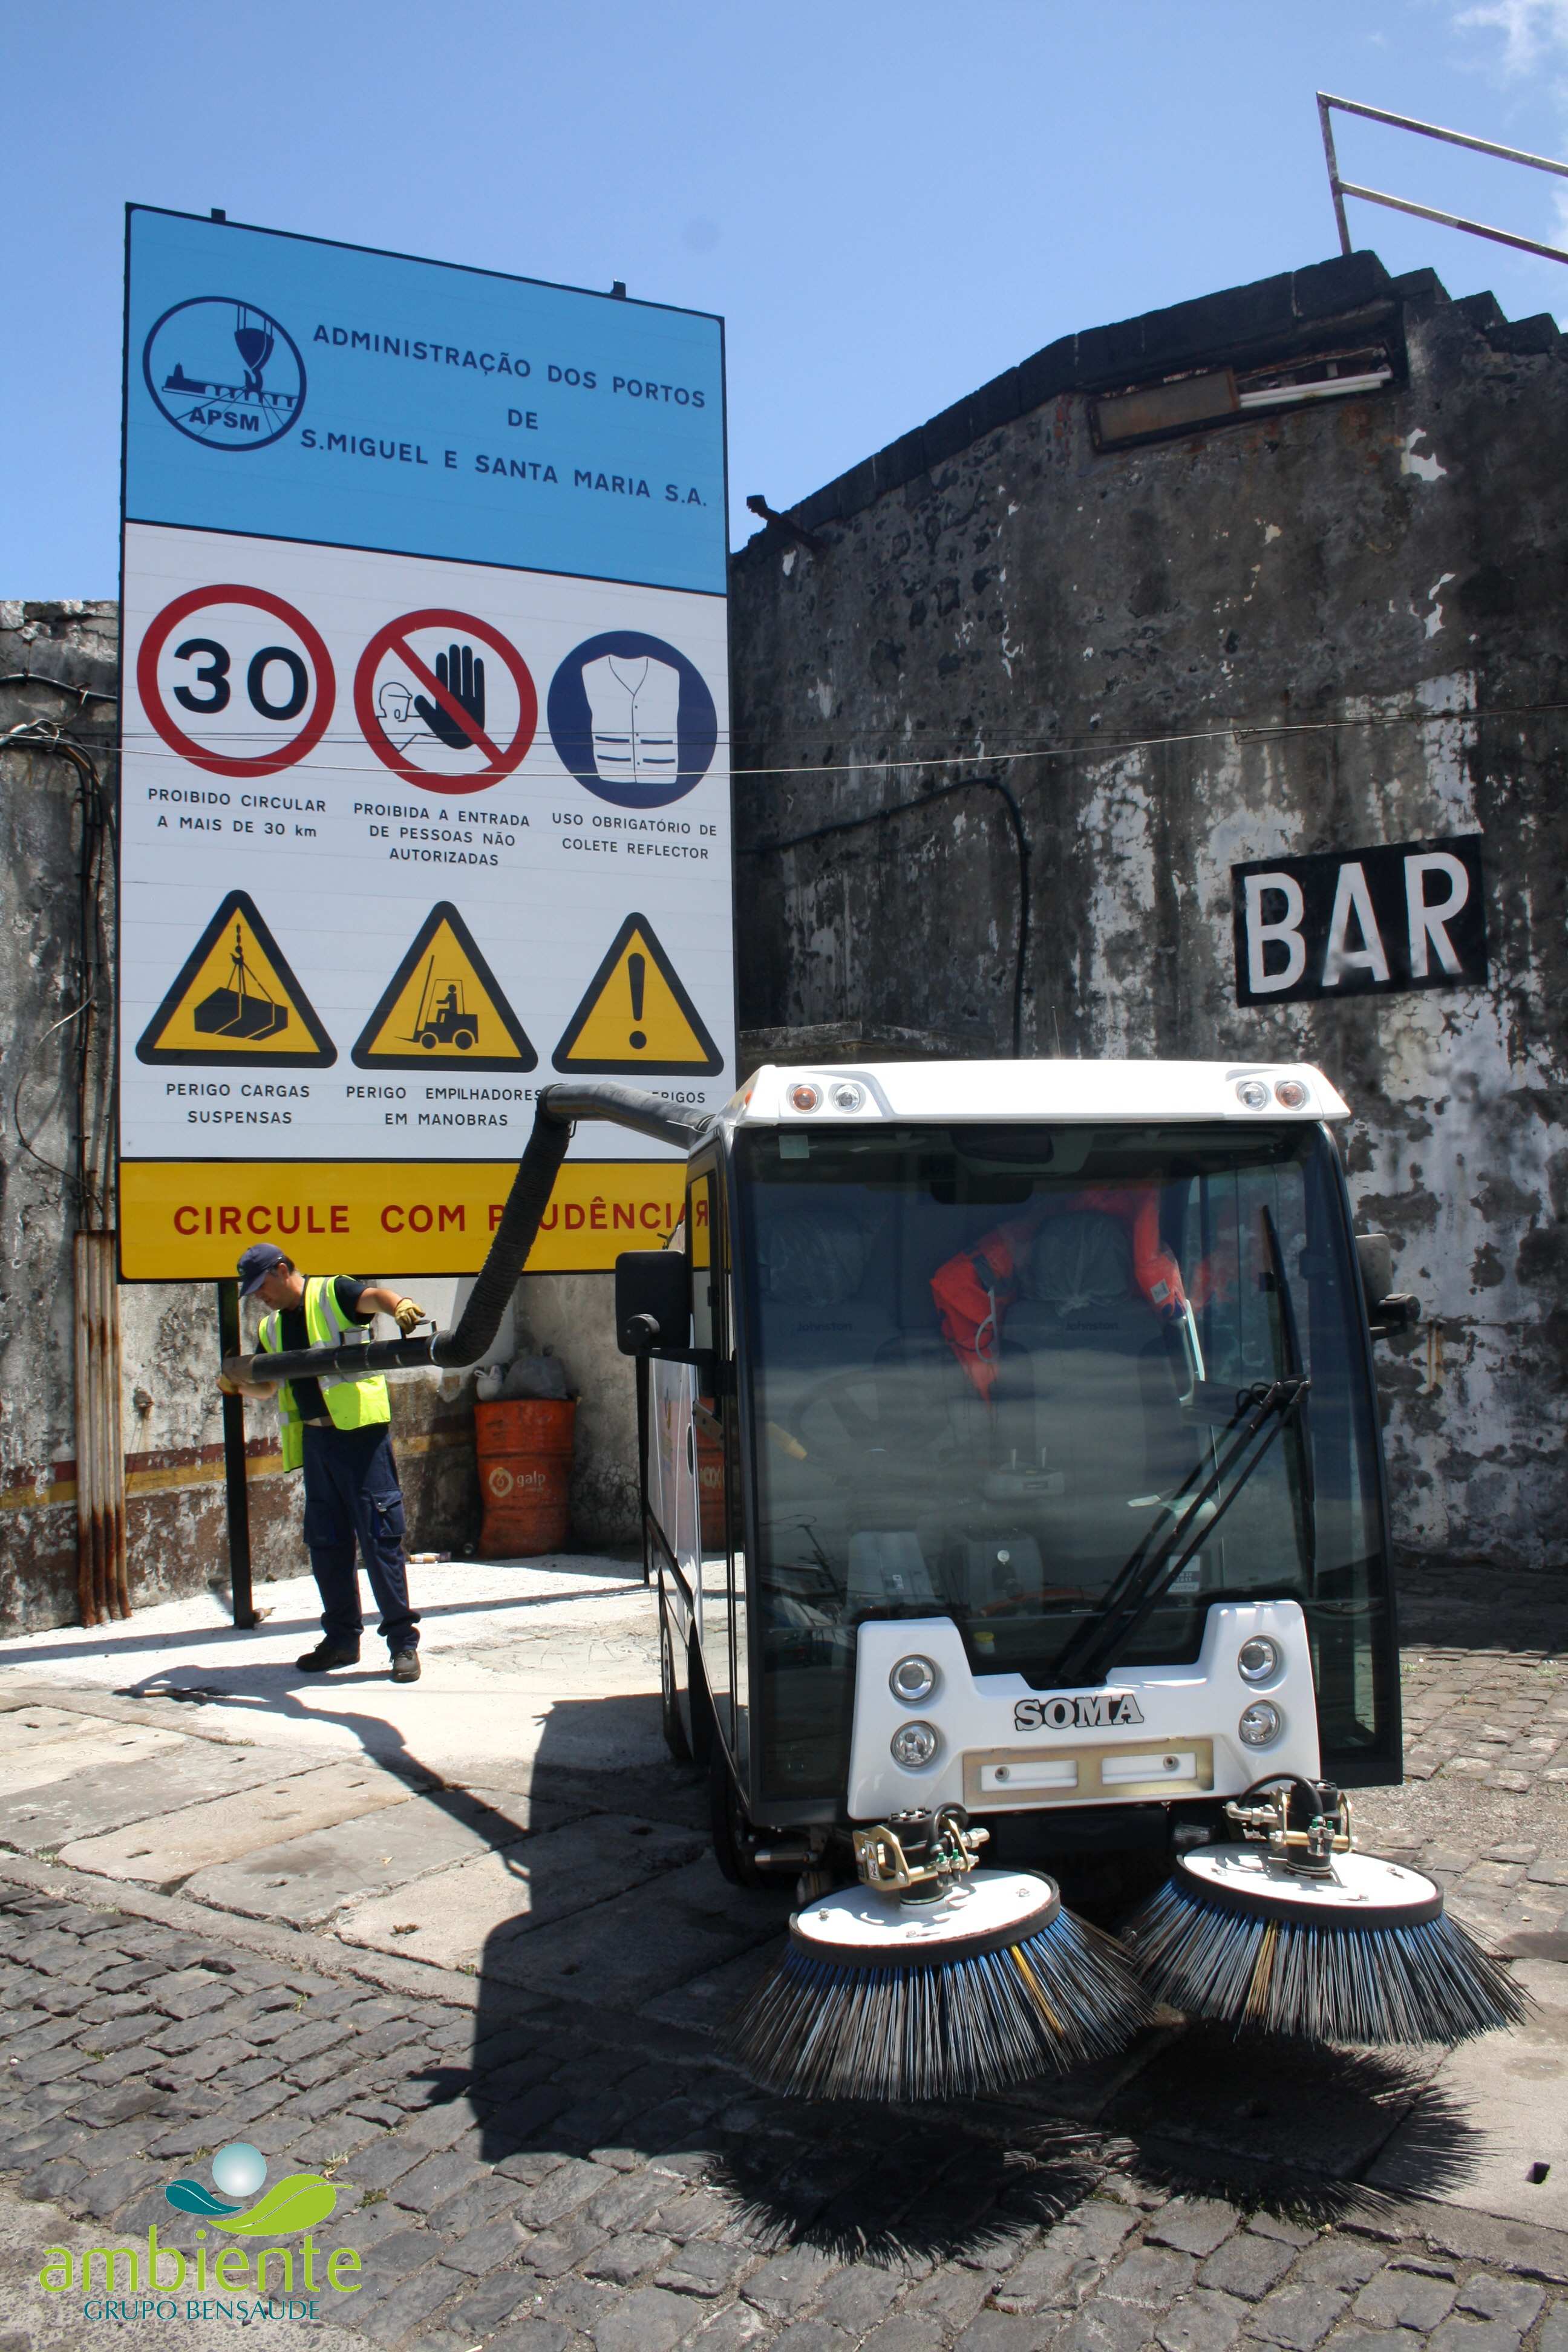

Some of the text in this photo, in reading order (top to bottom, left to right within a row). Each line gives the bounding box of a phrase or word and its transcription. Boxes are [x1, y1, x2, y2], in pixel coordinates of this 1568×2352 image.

[313, 325, 705, 408] ADMINISTRAÇÃO DOS PORTOS
[189, 406, 260, 432] APSM
[508, 409, 538, 430] DE
[301, 429, 707, 506] S.MIGUEL E SANTA MARIA S.A.
[173, 638, 309, 721] 30
[149, 788, 325, 812] PROIBIDO CIRCULAR
[354, 803, 529, 826] PROIBIDA A ENTRADA
[553, 813, 716, 835] USO OBRIGATÓRIO DE
[157, 816, 316, 837] A MAIS DE 30 km
[370, 825, 515, 846] DE PESSOAS NÃO
[390, 848, 498, 866] AUTORIZADAS
[563, 838, 708, 859] COLETE REFLECTOR
[1244, 852, 1469, 993] BAR
[167, 1083, 309, 1097] PERIGO CARGAS
[347, 1086, 542, 1101] PERIGO EMPILHADORES
[188, 1111, 292, 1123] SUSPENSAS
[385, 1113, 508, 1126] EM MANOBRAS
[174, 1205, 350, 1235] CIRCULE
[381, 1204, 465, 1233] COM
[488, 1196, 685, 1232] PUDÊNCI
[517, 1471, 546, 1487] galp
[1014, 1694, 1144, 1731] SOMA
